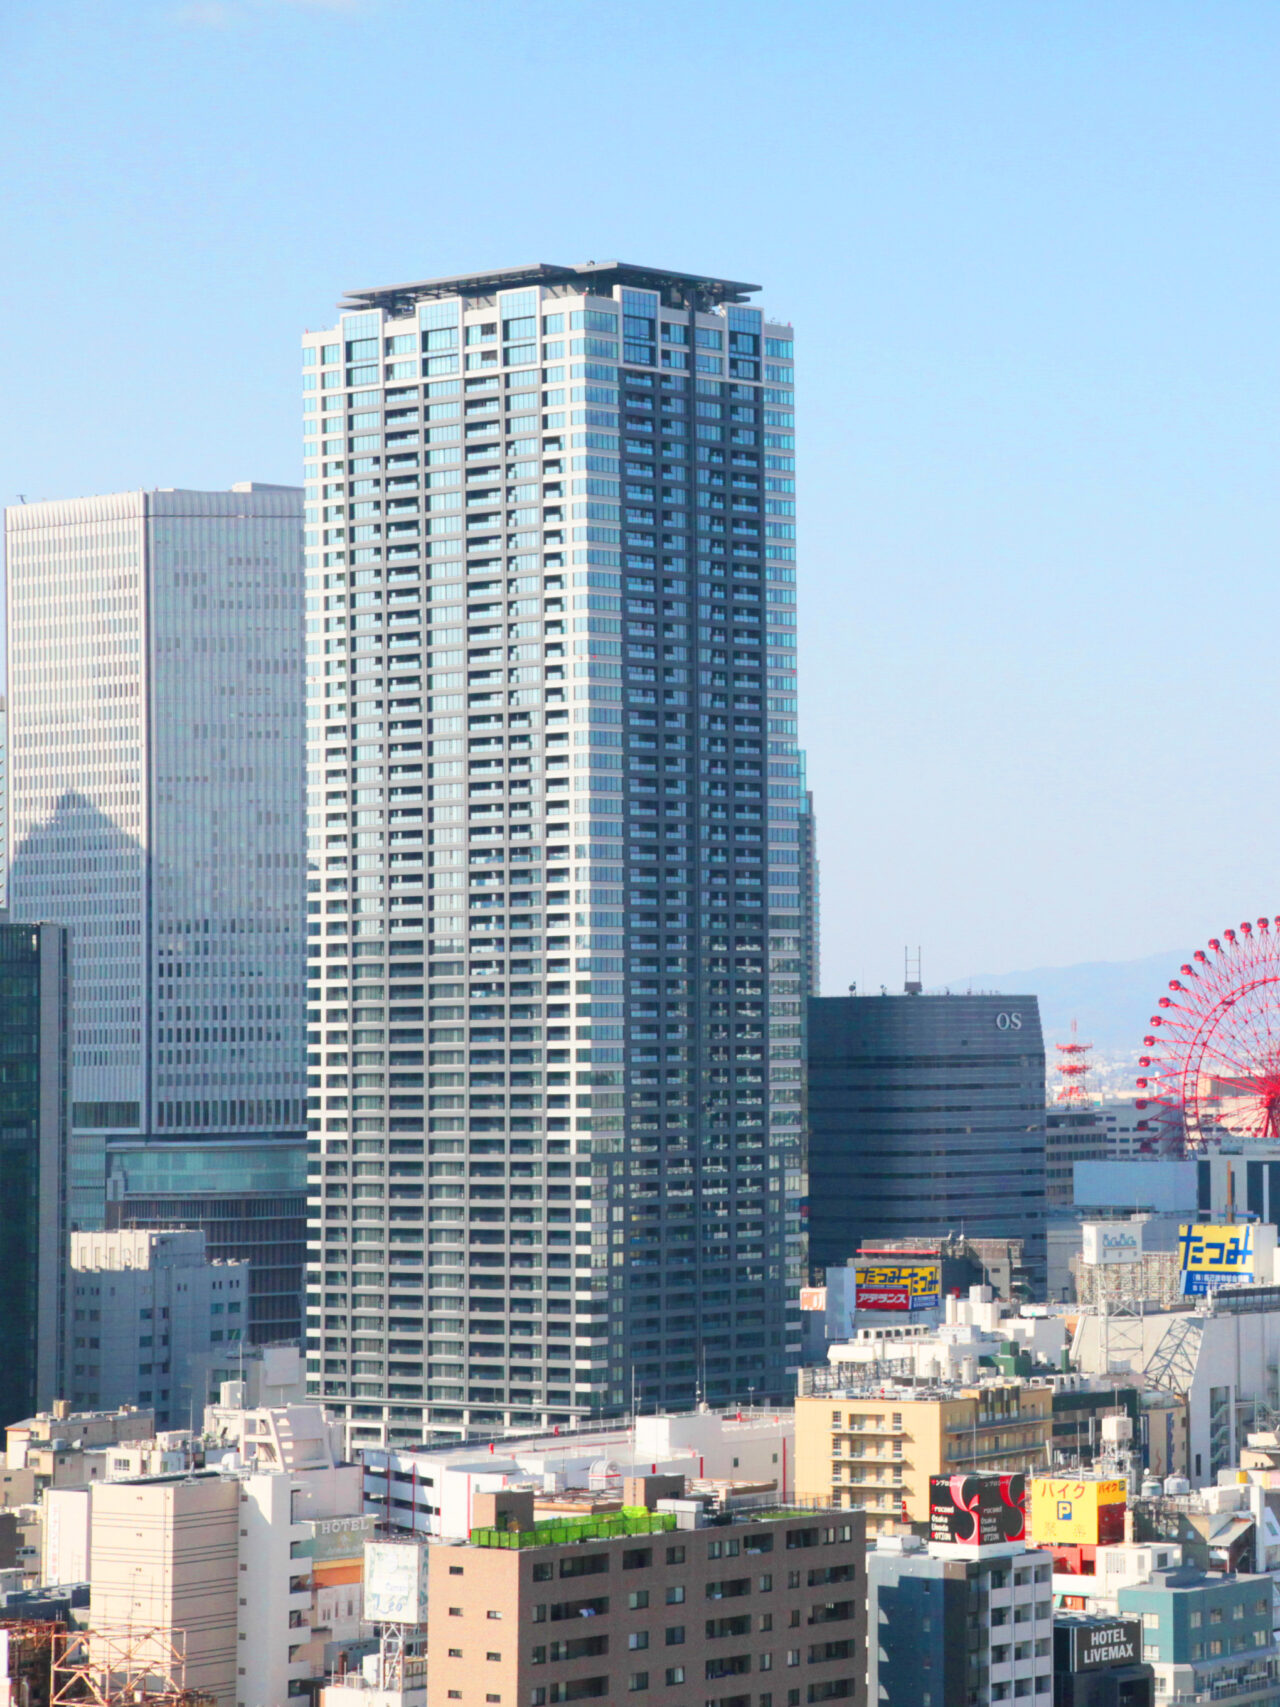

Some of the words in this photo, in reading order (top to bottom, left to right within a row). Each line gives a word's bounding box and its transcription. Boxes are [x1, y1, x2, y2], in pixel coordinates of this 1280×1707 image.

[996, 1012, 1022, 1030] OS
[1179, 1225, 1253, 1270] たつみ
[857, 1293, 906, 1304] アデランス
[1041, 1483, 1086, 1499] バイク
[1098, 1483, 1118, 1494] バイク
[1059, 1502, 1071, 1519] P
[321, 1519, 370, 1535] HOTEL
[1091, 1628, 1127, 1646] HOTEL
